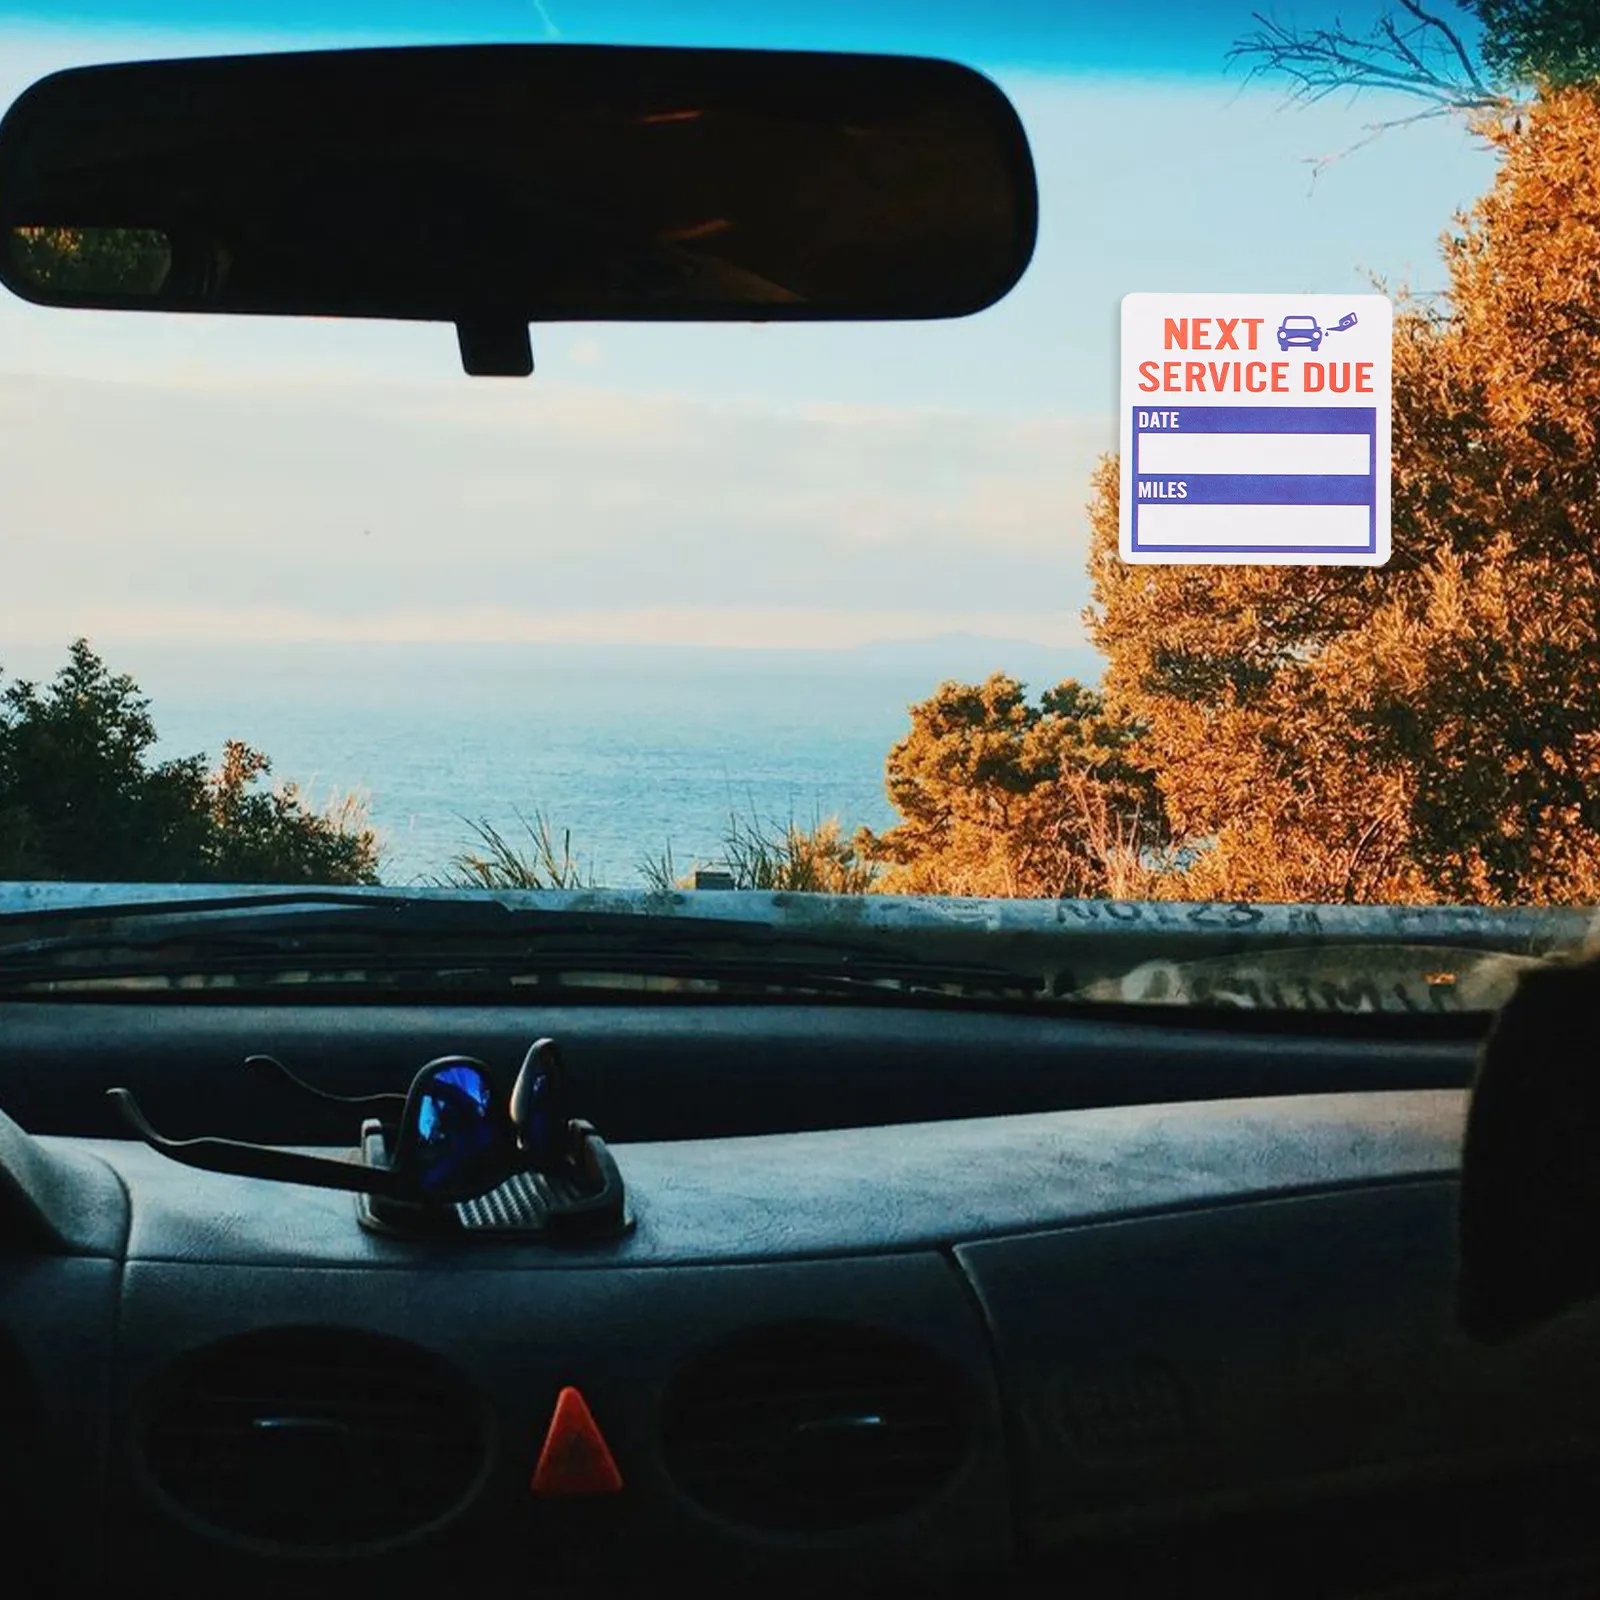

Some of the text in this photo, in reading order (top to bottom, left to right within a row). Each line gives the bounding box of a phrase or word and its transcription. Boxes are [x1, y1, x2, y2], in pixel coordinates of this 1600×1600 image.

[1164, 318, 1264, 350] NEXT
[1138, 361, 1374, 393] SERVICE DUE
[1138, 412, 1180, 429] DATE
[1138, 482, 1188, 499] MILES
